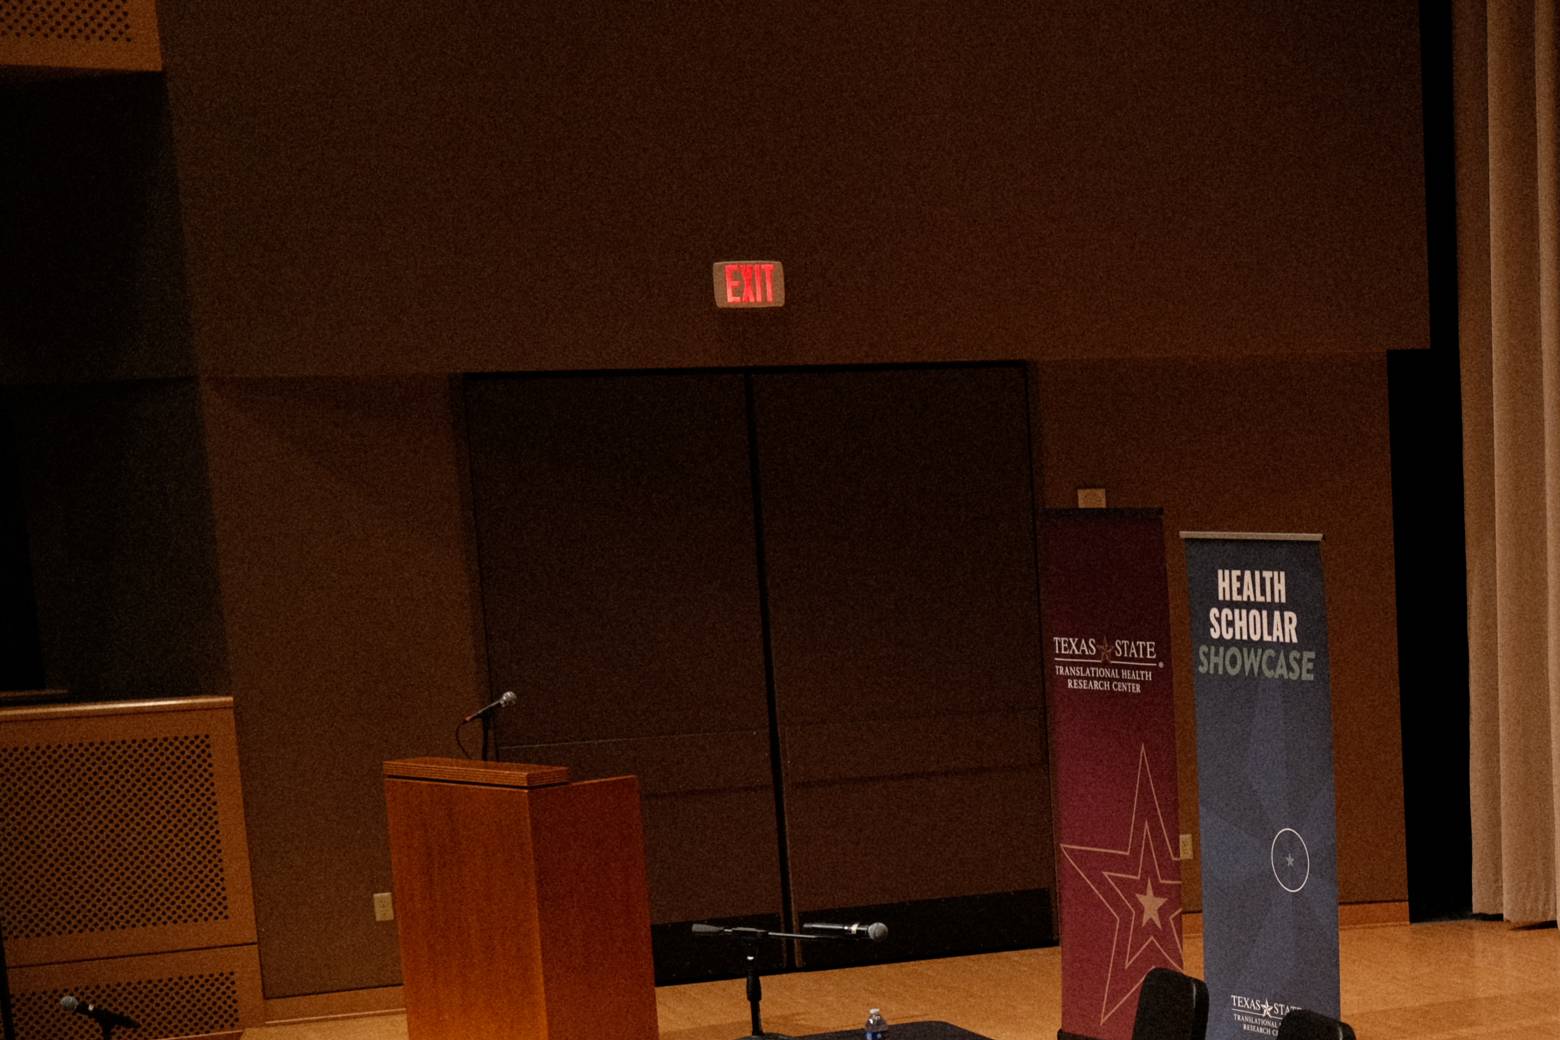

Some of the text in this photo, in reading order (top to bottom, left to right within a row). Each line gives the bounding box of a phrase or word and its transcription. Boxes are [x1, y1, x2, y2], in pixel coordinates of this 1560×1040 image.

[724, 263, 775, 303] EXIT
[1217, 569, 1286, 603] HEALTH
[1209, 607, 1298, 643] SCHOLAR
[1053, 636, 1157, 659] TEXAS STATE
[1055, 665, 1152, 681] TRANSLATIONAL HEALTH
[1198, 644, 1316, 681] SHOWCASE
[1067, 679, 1141, 693] RESEARCH CENTER
[1231, 994, 1302, 1016] TEXAS STA
[1234, 1013, 1277, 1029] TRANSLATIONAL
